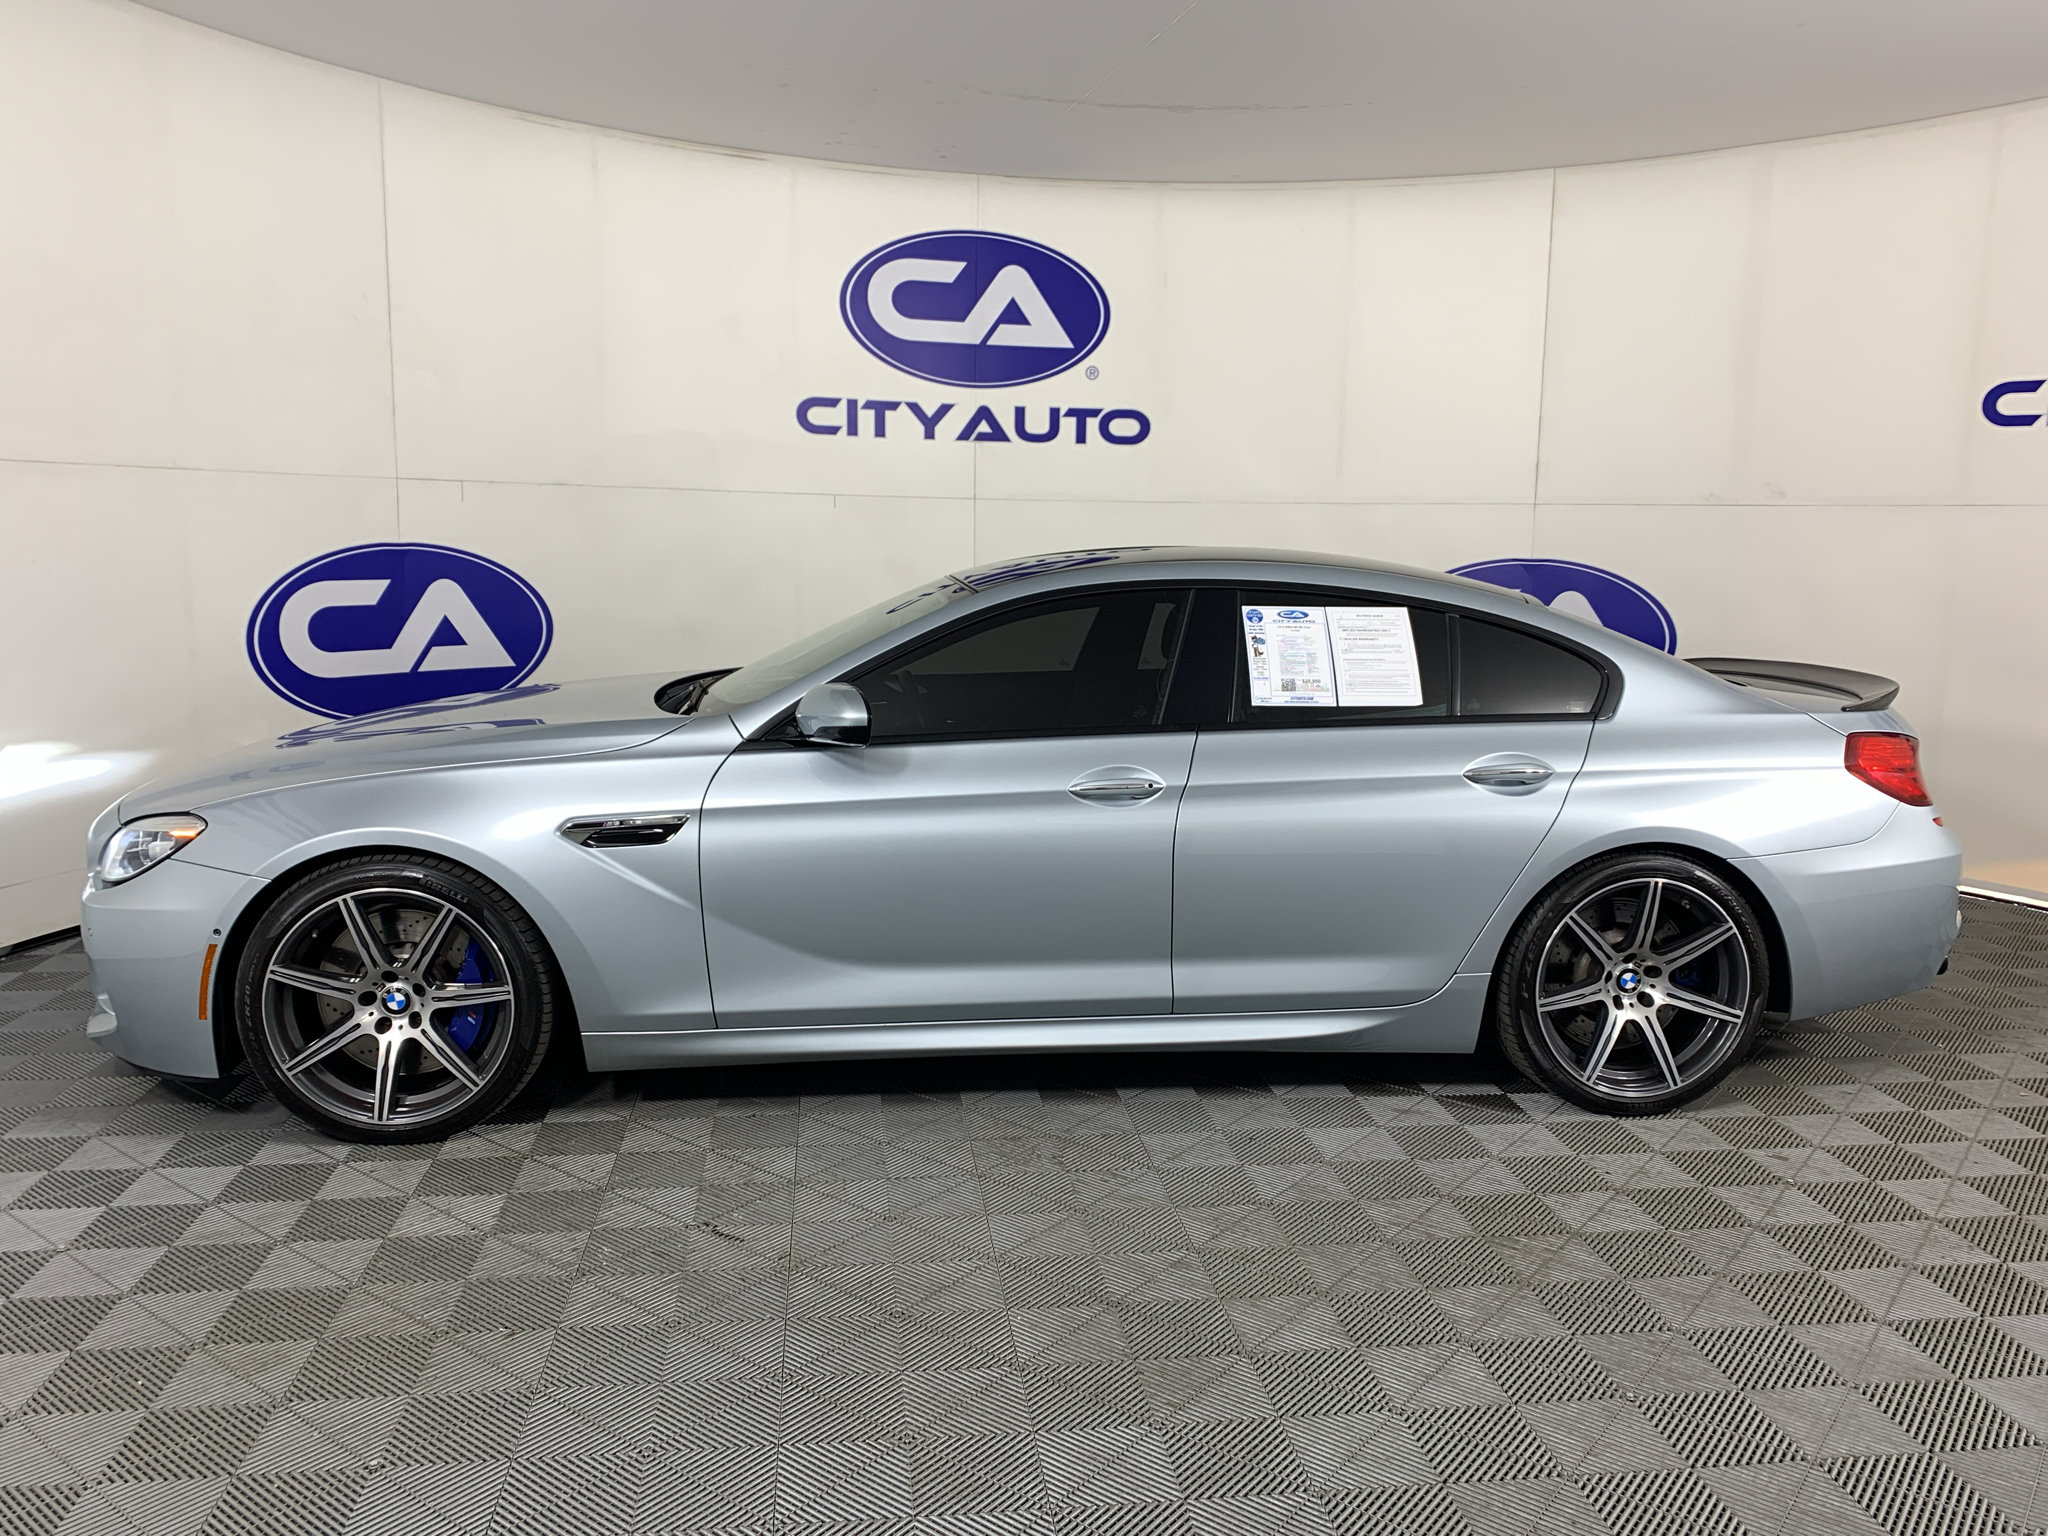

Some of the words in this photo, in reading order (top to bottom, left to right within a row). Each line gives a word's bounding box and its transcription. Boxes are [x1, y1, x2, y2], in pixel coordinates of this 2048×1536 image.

[867, 257, 1075, 349] CA
[795, 396, 956, 441] CITY
[955, 404, 1152, 445] AUTO
[1982, 379, 2048, 427] C
[278, 577, 517, 679] CA
